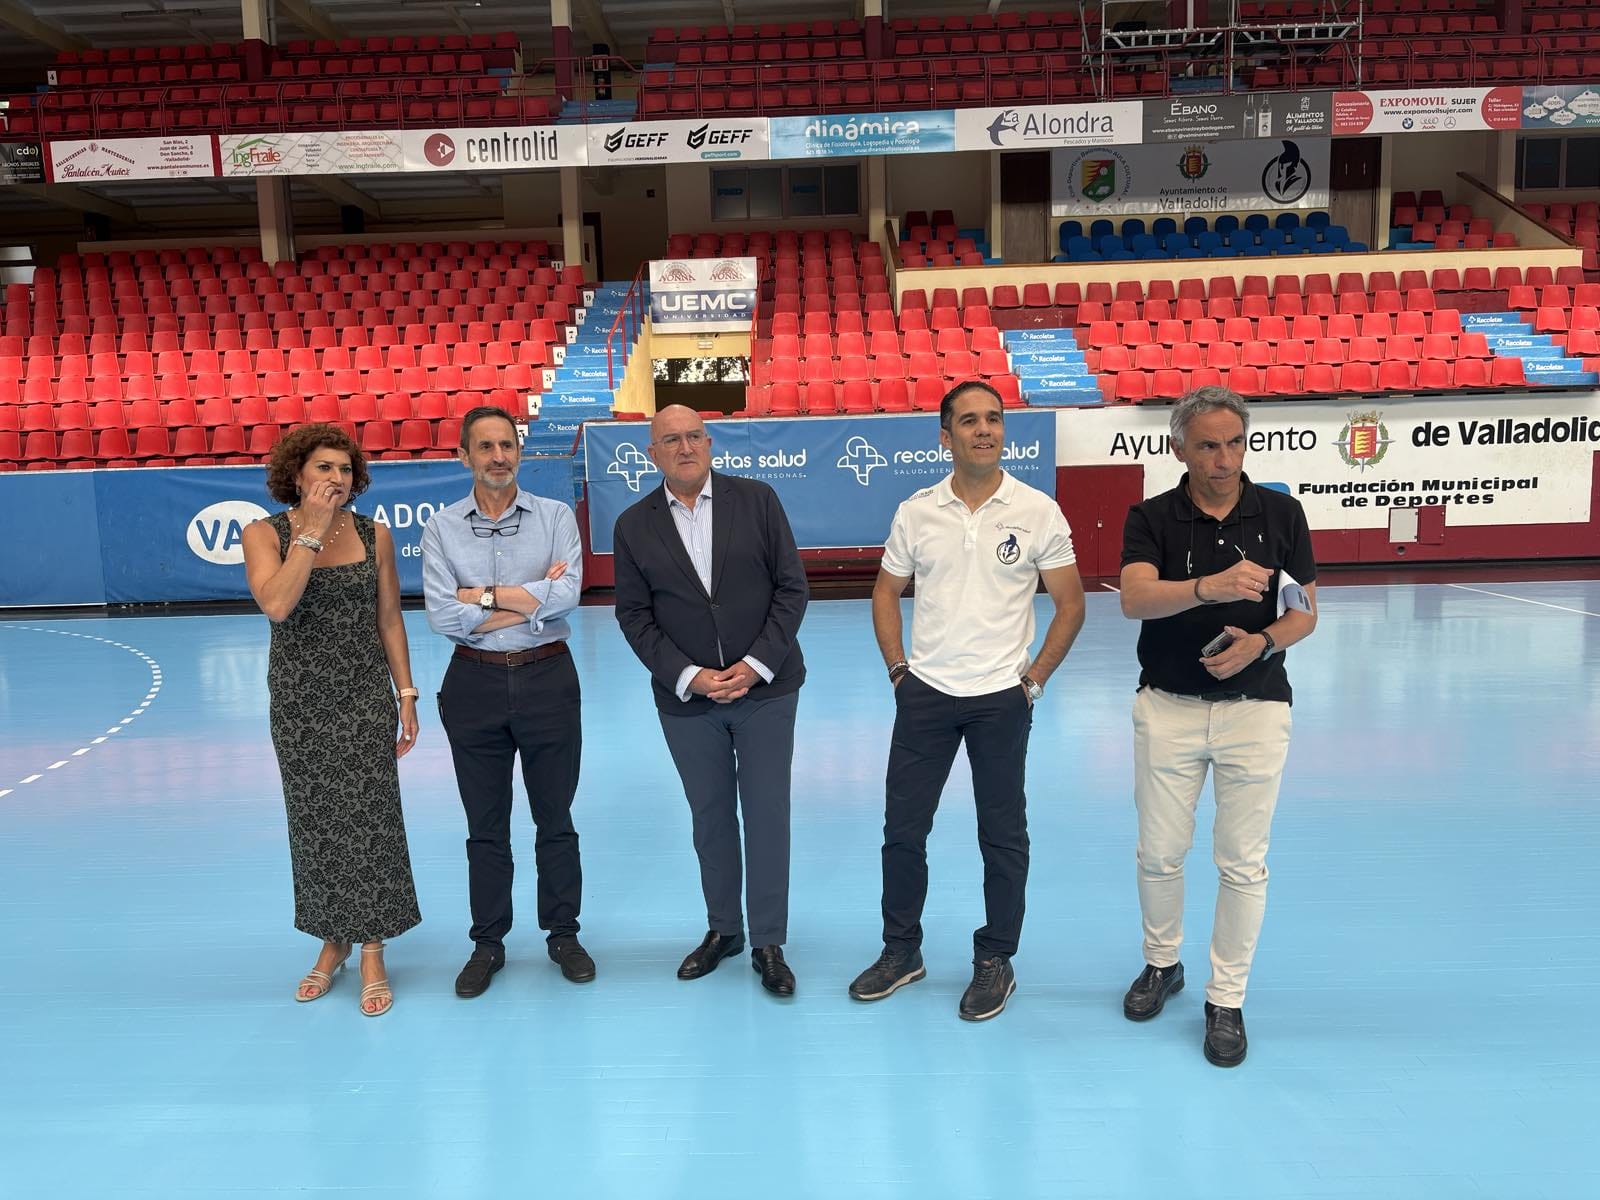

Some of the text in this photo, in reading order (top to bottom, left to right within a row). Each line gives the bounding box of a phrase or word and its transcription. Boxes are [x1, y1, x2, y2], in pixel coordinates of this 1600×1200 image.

[1171, 100, 1218, 116] ÉBANO
[1380, 97, 1477, 108] EXPOMOVIL SUJER
[1383, 107, 1473, 116] www.expomovilsujer.com
[805, 116, 921, 141] dinámica
[1003, 110, 1114, 135] La Alondra
[625, 133, 670, 148] GEFF
[708, 129, 754, 144] GEFF
[466, 130, 558, 163] centrolid
[232, 147, 281, 168] IngFraile
[1159, 186, 1228, 196] Ayuntamiento de
[1159, 196, 1227, 210] Valladolid
[659, 270, 696, 282] NONNA
[661, 293, 748, 312] UEMC
[663, 312, 746, 320] UNIVERSIDAD
[557, 423, 579, 431] Recolet
[1109, 426, 1317, 460] Ayuento
[1411, 421, 1450, 447] de
[758, 448, 807, 468] salud
[894, 440, 1040, 464] recole alud
[1298, 477, 1539, 496] Fundación Municipal
[1341, 493, 1495, 509] de Deportes
[401, 543, 422, 558] de
